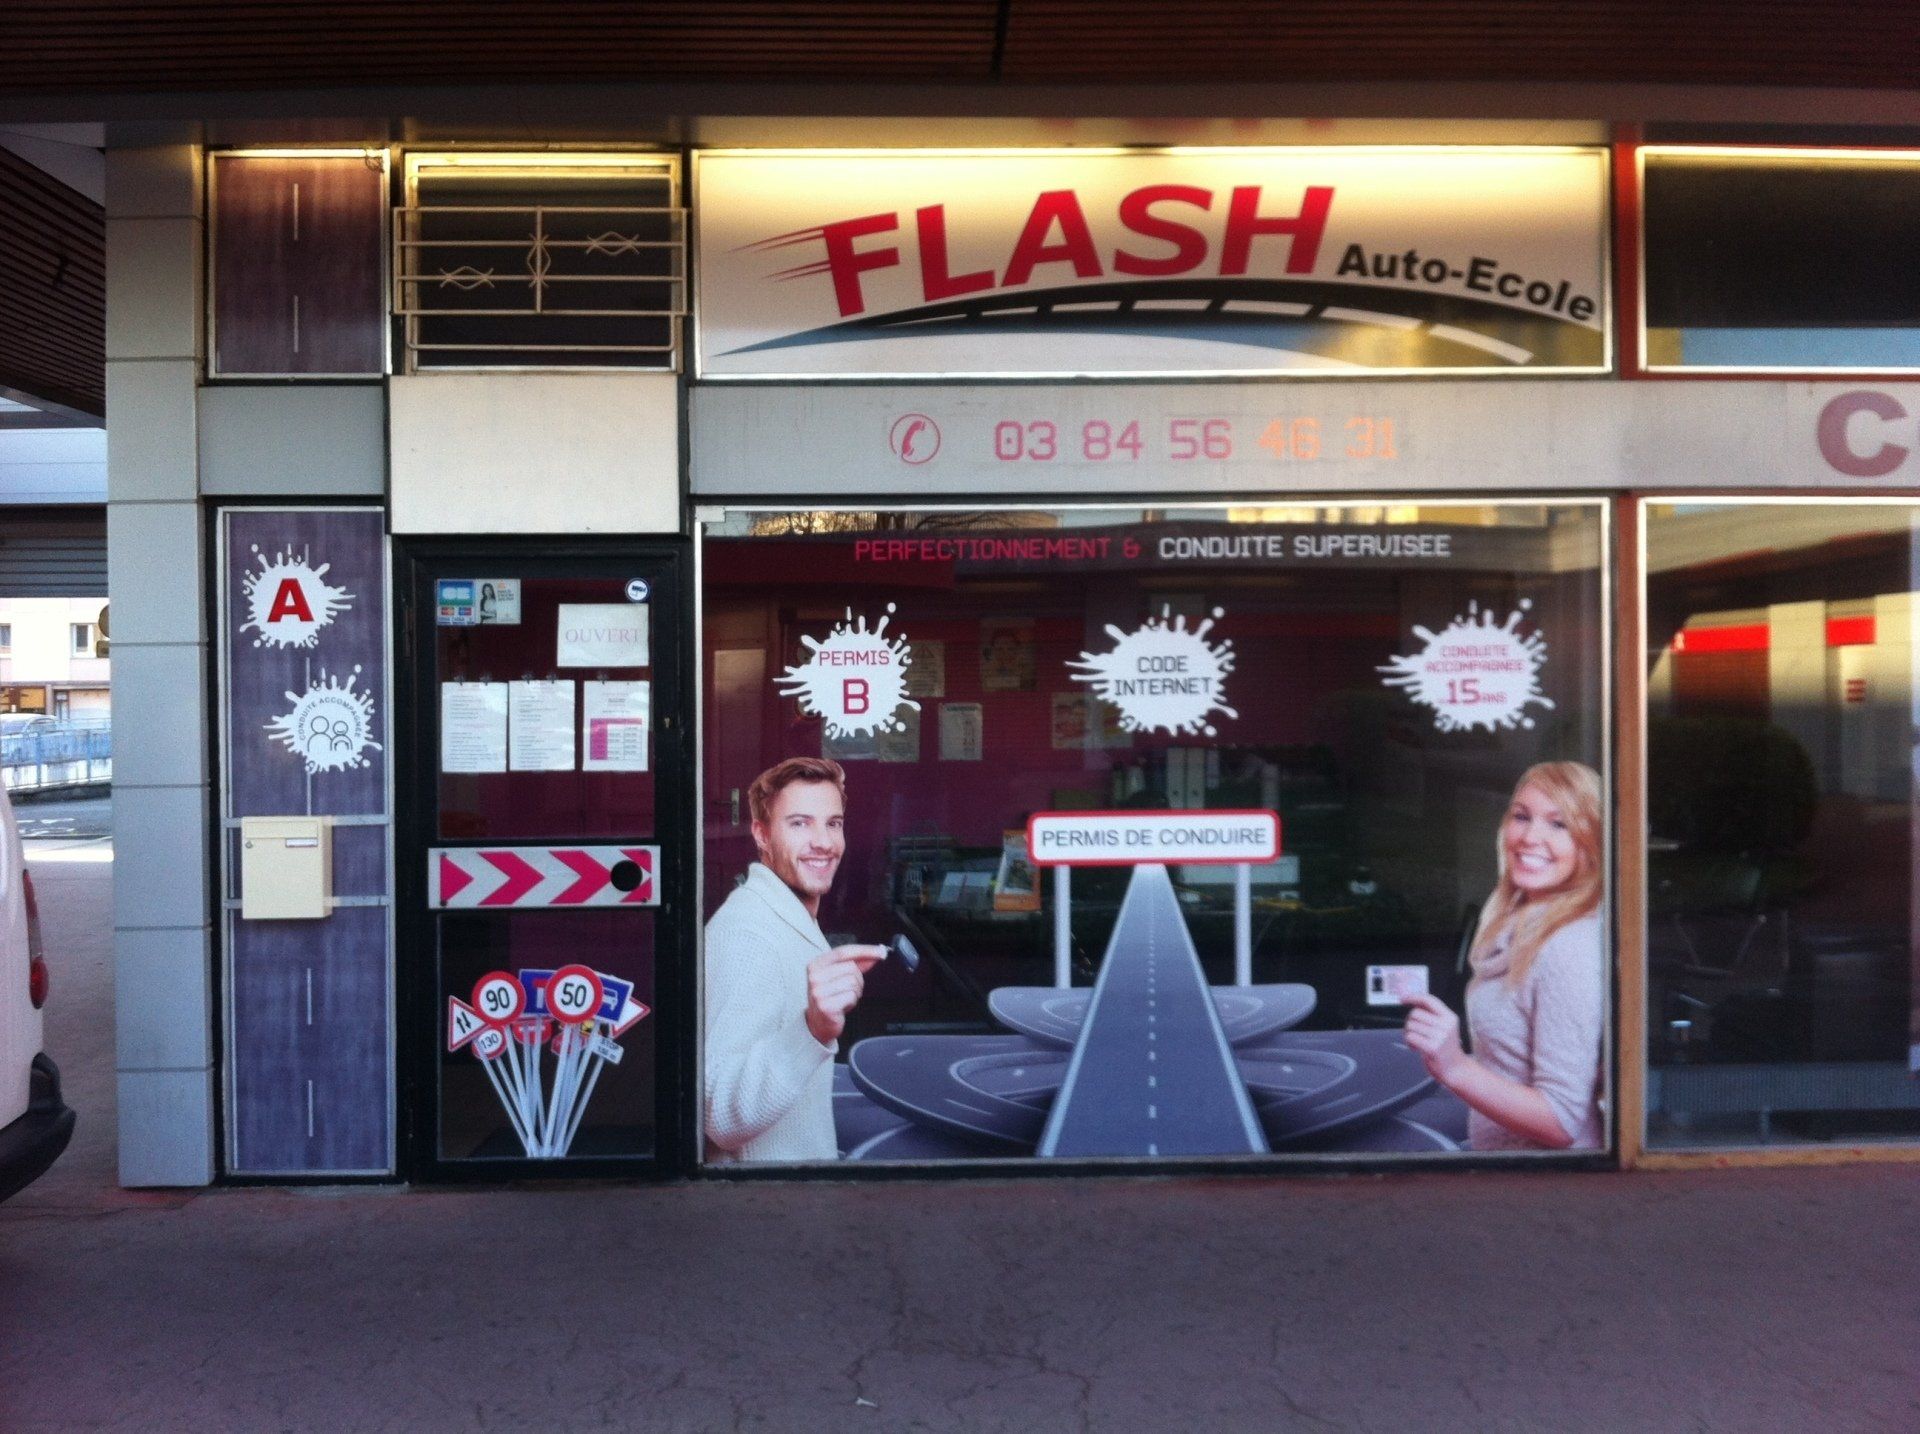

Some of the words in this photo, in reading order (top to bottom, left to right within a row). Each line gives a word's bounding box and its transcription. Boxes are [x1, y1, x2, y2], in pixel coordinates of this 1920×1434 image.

[820, 183, 1335, 317] FLASH
[1337, 243, 1596, 321] Auto-Ecole
[994, 420, 1057, 461] 03
[1082, 419, 1144, 460] 84
[1170, 418, 1233, 460] 56
[1258, 417, 1321, 459] 46
[1343, 416, 1398, 459] 31
[855, 538, 1111, 561] PERFECTIONNEMENT
[1159, 535, 1284, 559] CONDUITE
[1293, 534, 1451, 558] SUPERVISEE
[267, 577, 315, 623] A
[565, 628, 641, 644] OUVERT
[819, 650, 890, 666] PERMIS
[1137, 655, 1189, 673] CODE
[1441, 644, 1509, 658] CONDUITE
[843, 678, 869, 714] B
[1114, 677, 1212, 696] INTERNET
[1447, 678, 1481, 704] 15
[1041, 830, 1119, 848] PERMIS
[1125, 829, 1154, 846] DE
[1159, 828, 1267, 846] CONDUIRE
[485, 986, 511, 1012] 90
[560, 982, 588, 1008] 50
[480, 1032, 500, 1050] 130
